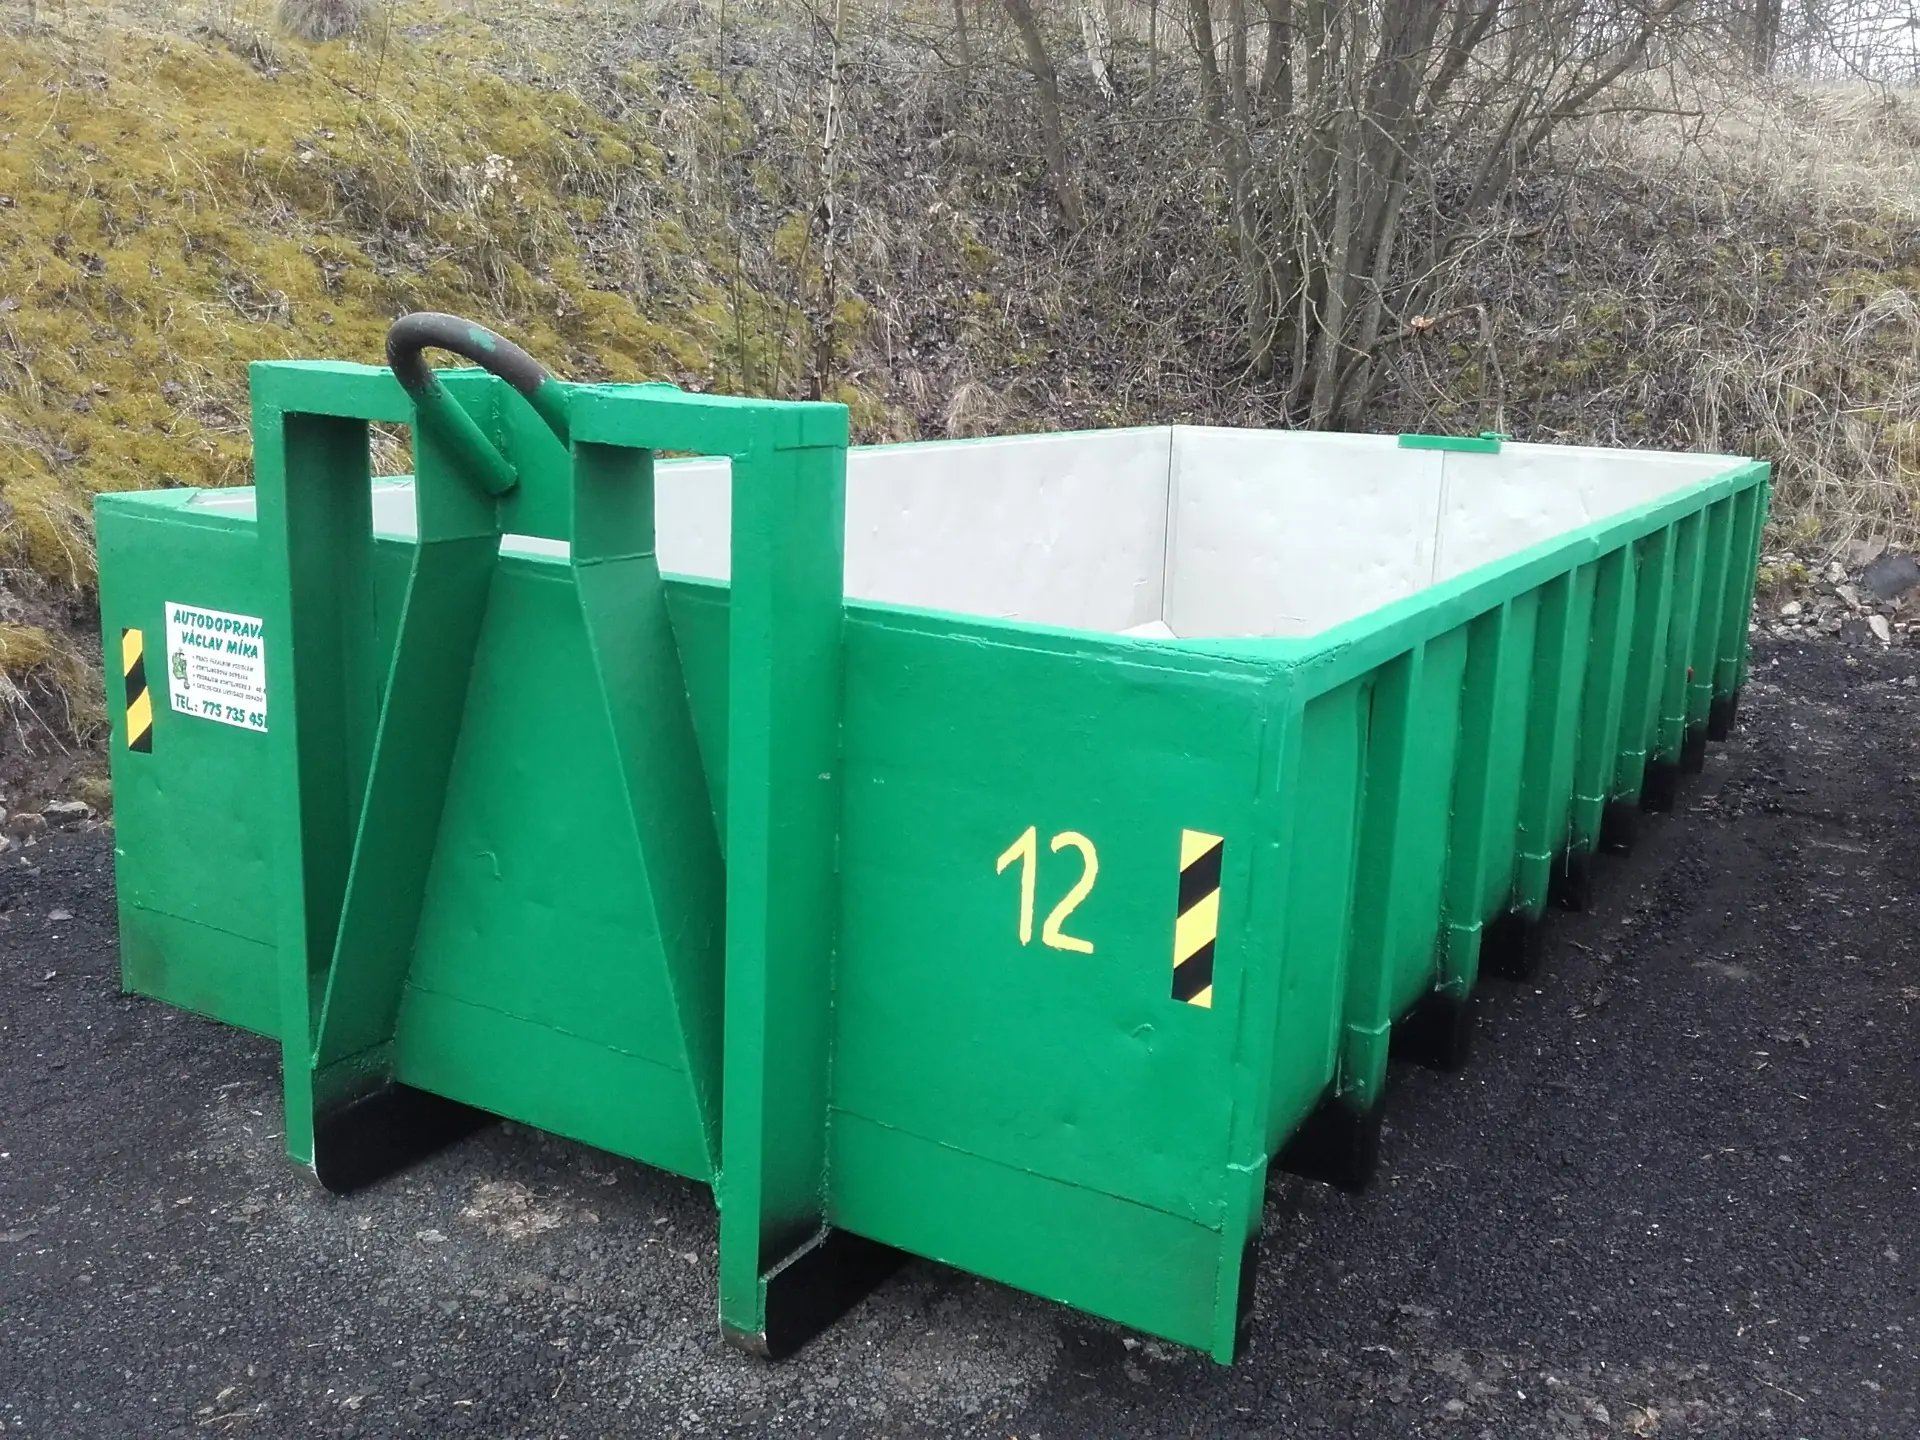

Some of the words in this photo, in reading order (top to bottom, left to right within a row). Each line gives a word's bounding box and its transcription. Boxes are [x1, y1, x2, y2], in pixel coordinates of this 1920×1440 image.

[181, 629, 223, 651] VÁCLAV
[226, 639, 258, 659] MÍKA
[202, 700, 222, 717] 775
[225, 706, 245, 723] 735
[249, 712, 267, 728] 45
[996, 825, 1099, 954] 12
